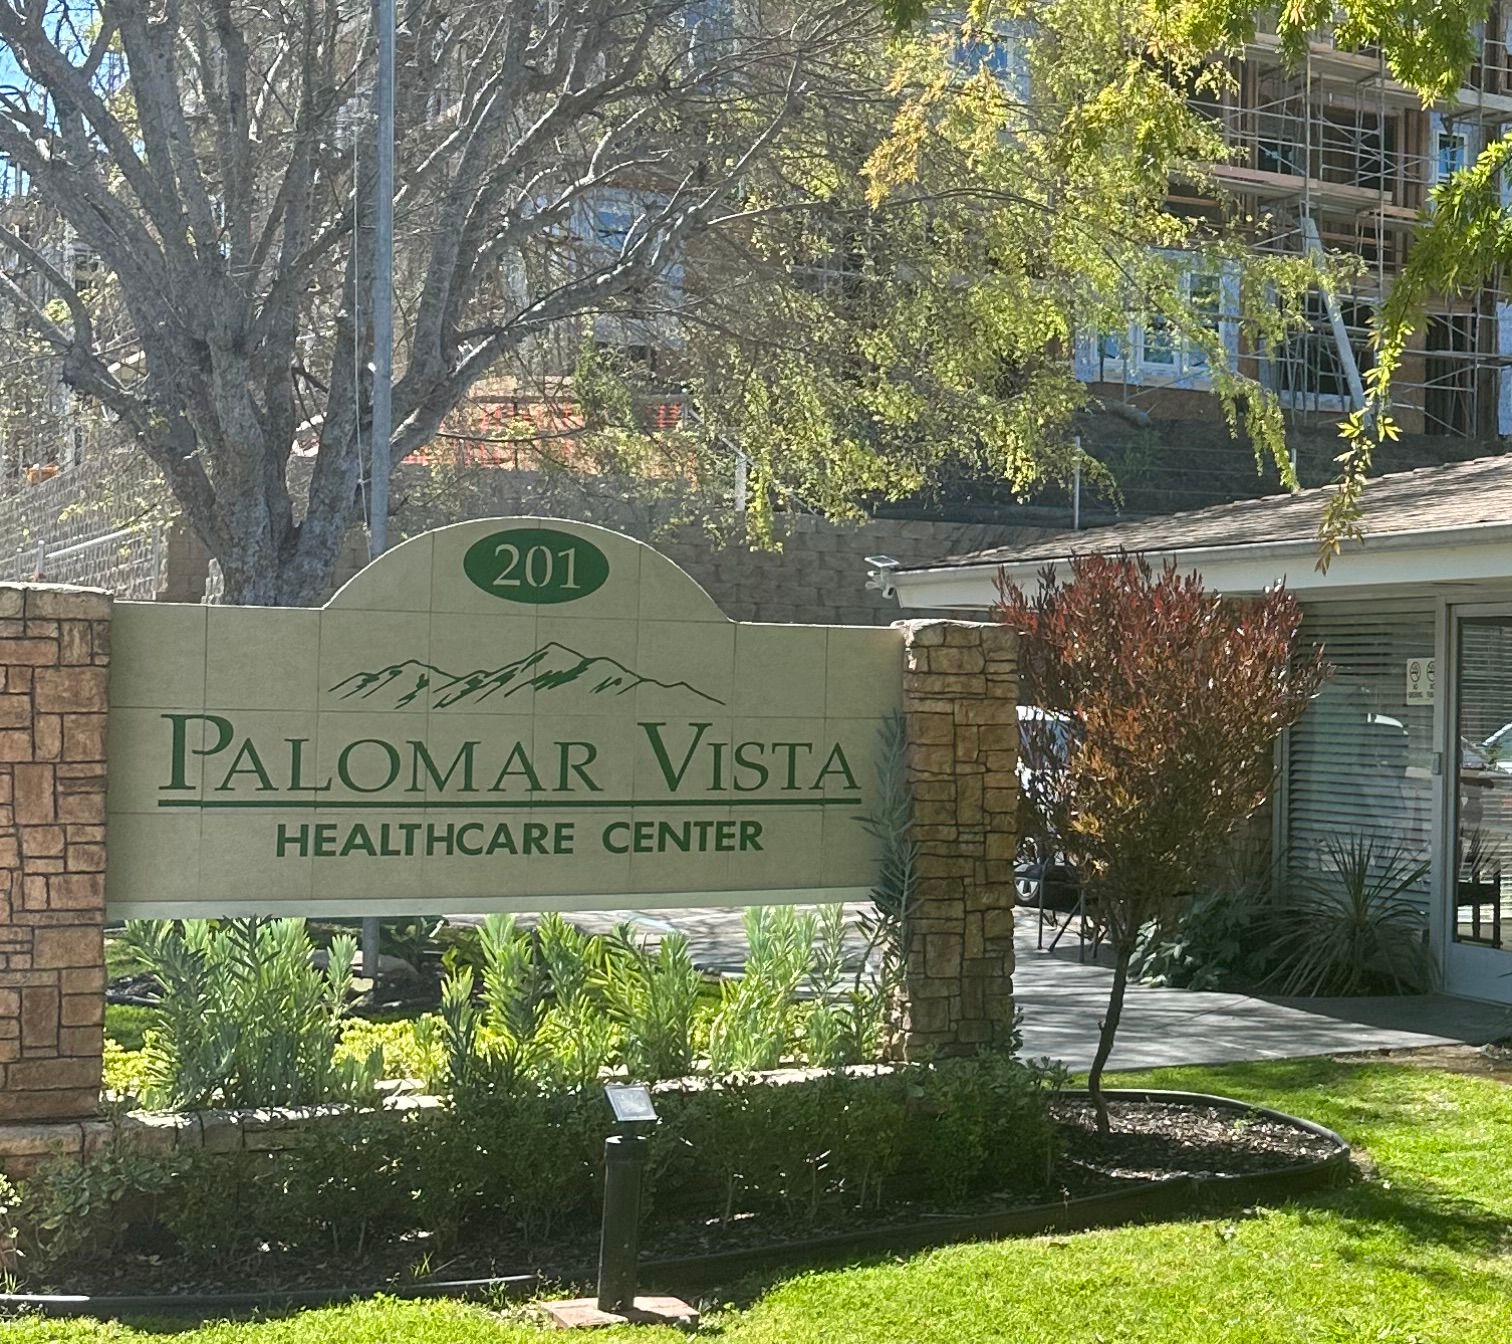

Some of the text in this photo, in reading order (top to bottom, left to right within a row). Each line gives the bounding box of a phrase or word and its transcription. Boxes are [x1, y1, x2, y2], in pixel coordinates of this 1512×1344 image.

[492, 544, 582, 590] 201
[159, 714, 861, 792] PALOMAR VISTA
[276, 820, 764, 856] HEALTHCARE CENTER
